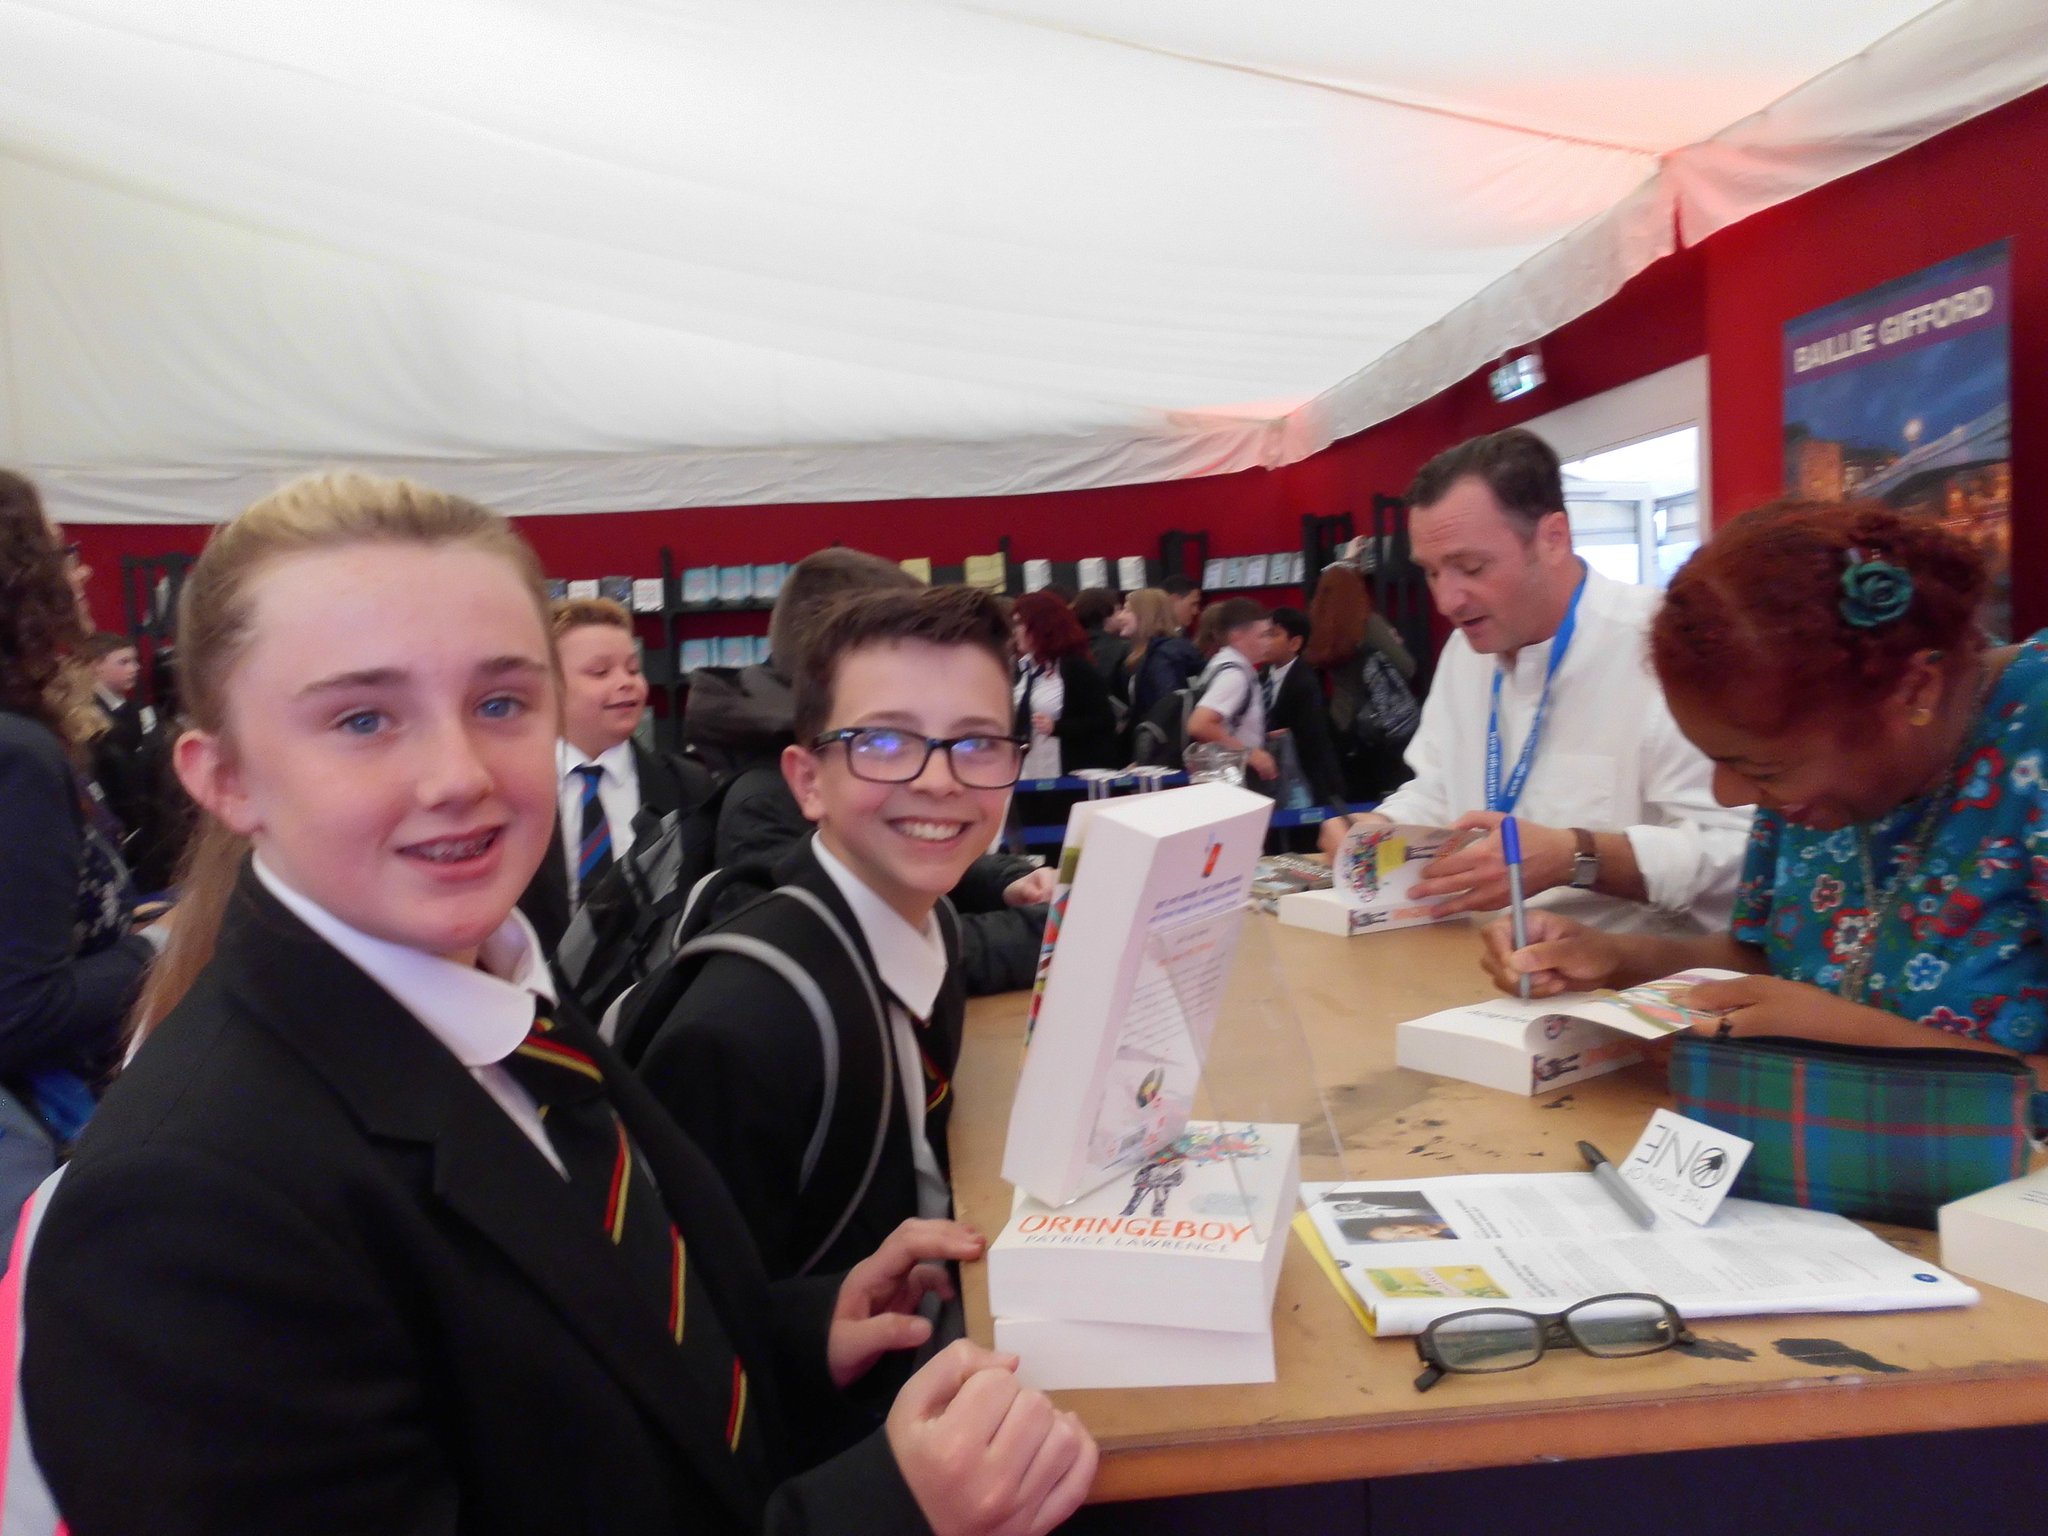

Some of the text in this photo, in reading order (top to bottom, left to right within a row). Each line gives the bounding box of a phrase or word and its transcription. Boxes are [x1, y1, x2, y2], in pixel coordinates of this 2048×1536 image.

[1794, 285, 1994, 373] BAILLIE GIFFORD
[1634, 1124, 1729, 1189] ONE
[1017, 1214, 1253, 1243] ORANGEBOY
[1024, 1233, 1233, 1254] PATRICE LAWRENCE
